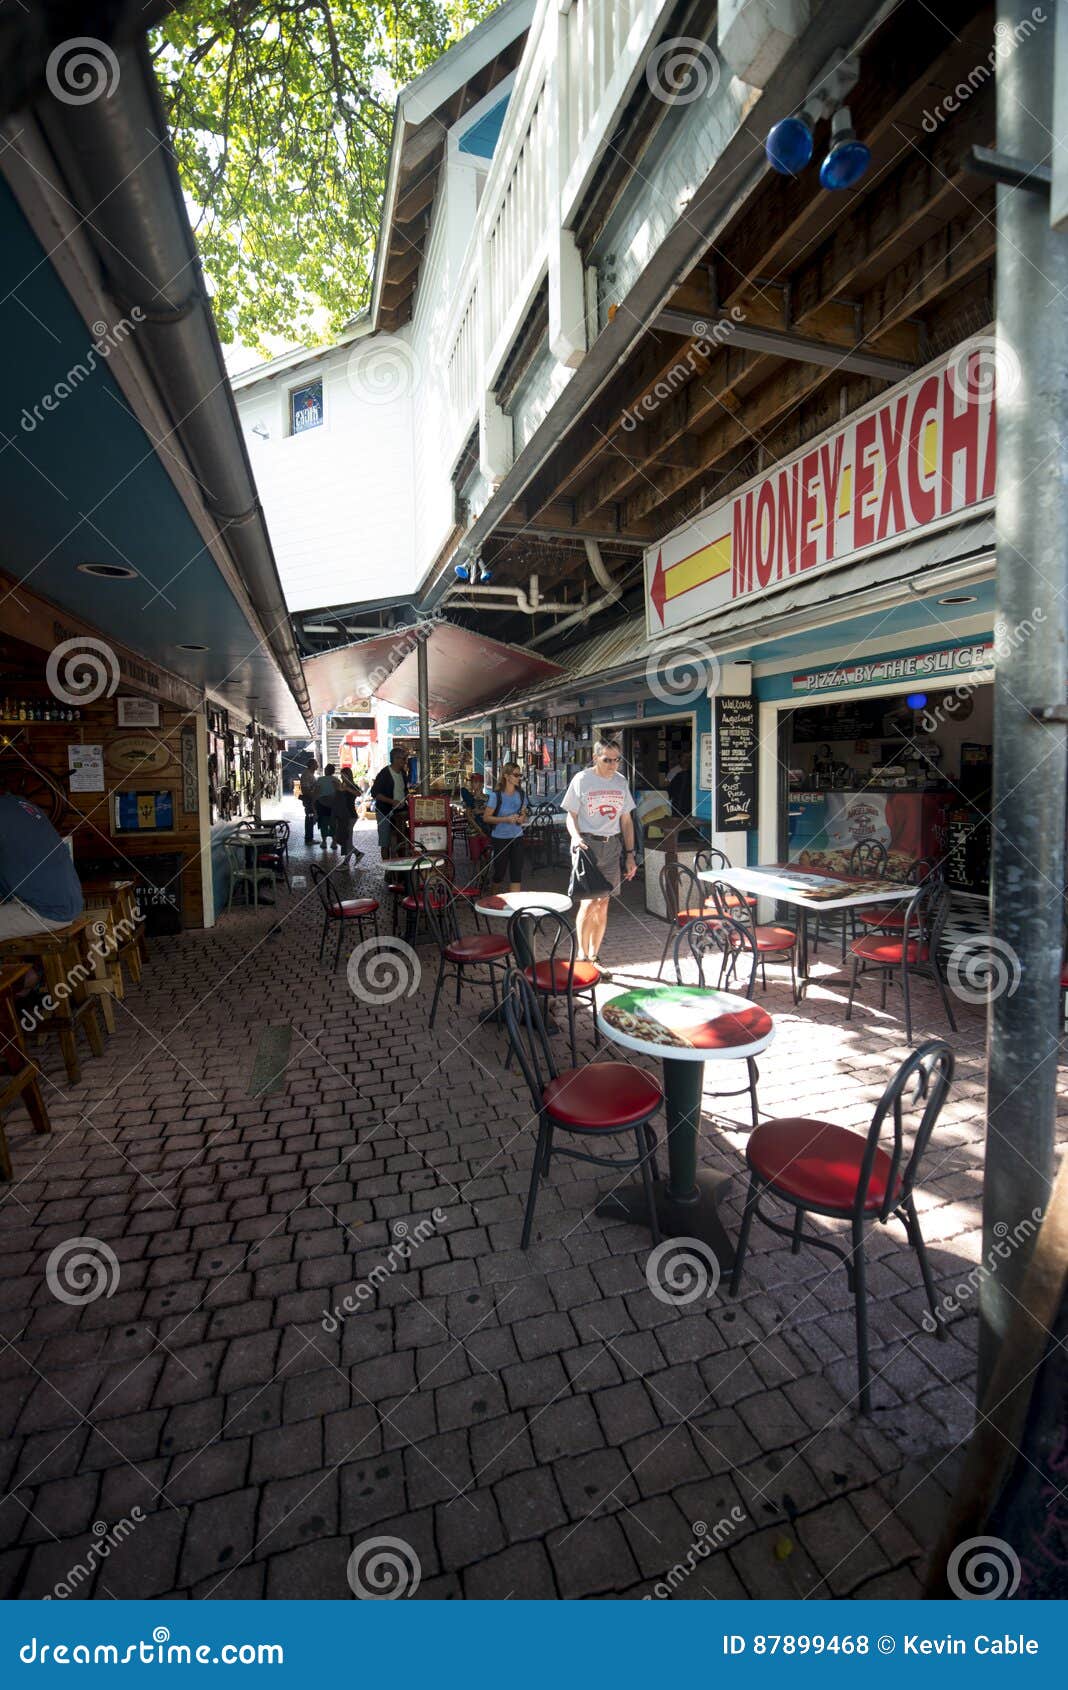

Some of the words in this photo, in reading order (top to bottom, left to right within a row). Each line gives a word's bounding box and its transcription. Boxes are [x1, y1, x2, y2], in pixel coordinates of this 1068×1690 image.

[732, 434, 845, 598] MONEY
[806, 672, 849, 690] PIZZA
[854, 665, 876, 683] BY
[881, 658, 917, 680] THE
[922, 645, 985, 673] SLICE
